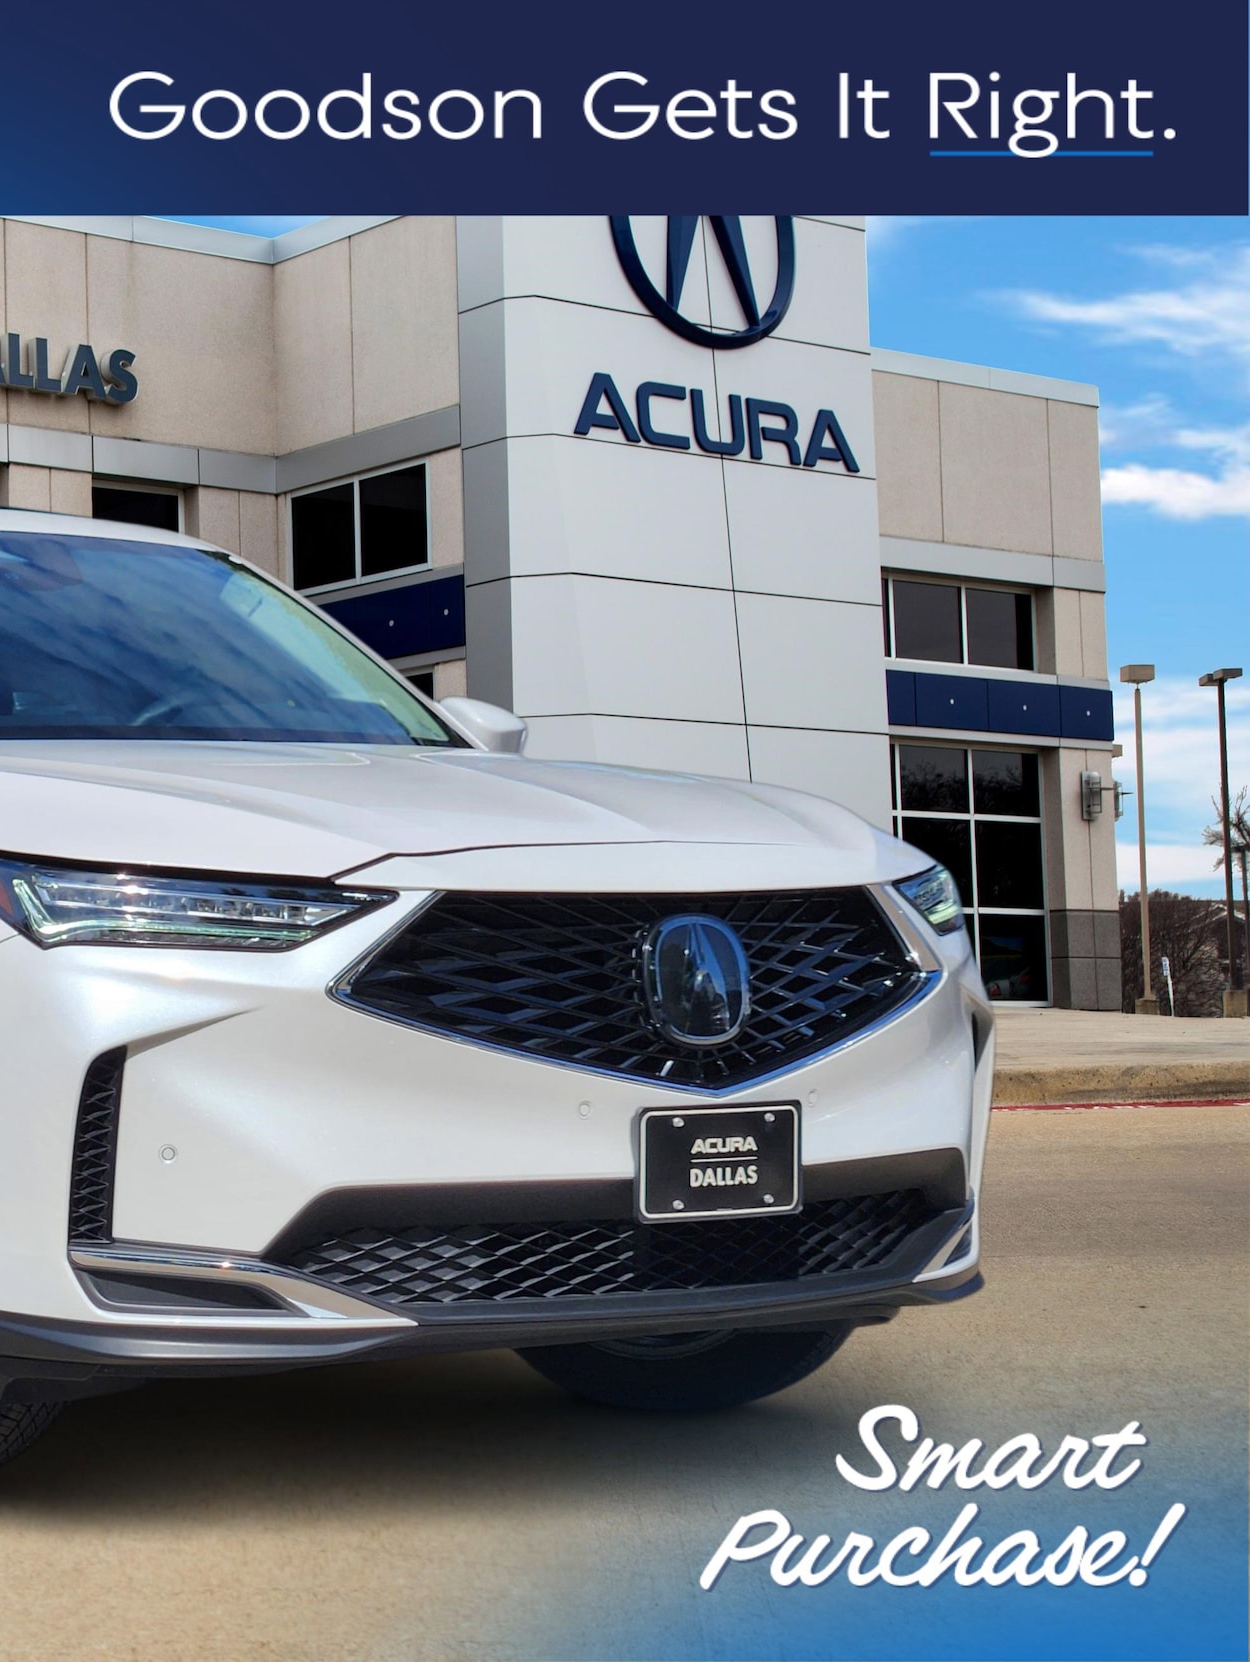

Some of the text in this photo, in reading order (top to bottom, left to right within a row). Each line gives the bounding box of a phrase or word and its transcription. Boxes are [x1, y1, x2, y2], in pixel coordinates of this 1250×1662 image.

[573, 372, 860, 473] ACURA
[690, 1136, 758, 1154] ACURA
[689, 1165, 758, 1187] DALLAS
